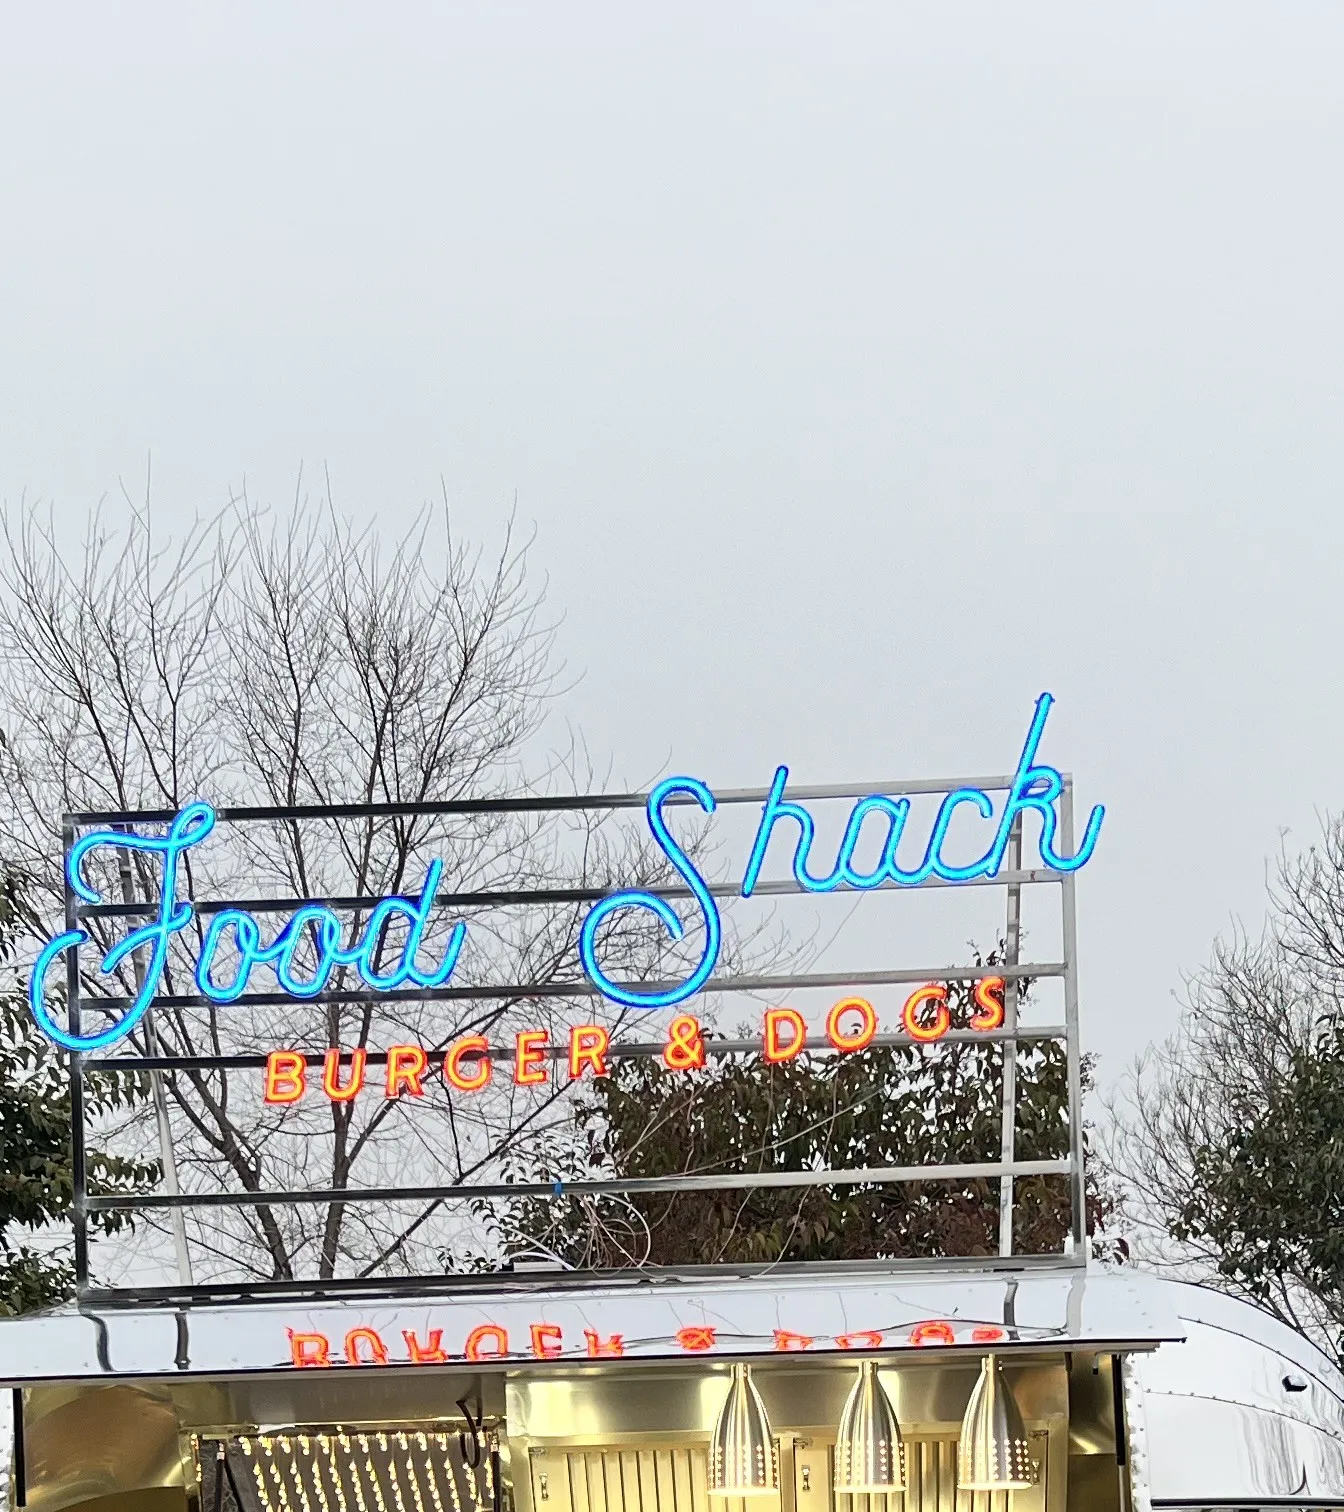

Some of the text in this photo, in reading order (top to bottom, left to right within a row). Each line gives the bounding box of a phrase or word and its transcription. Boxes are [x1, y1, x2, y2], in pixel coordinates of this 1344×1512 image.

[27, 691, 1107, 1053] Food Shack
[263, 974, 1006, 1105] BURGER & DOGS
